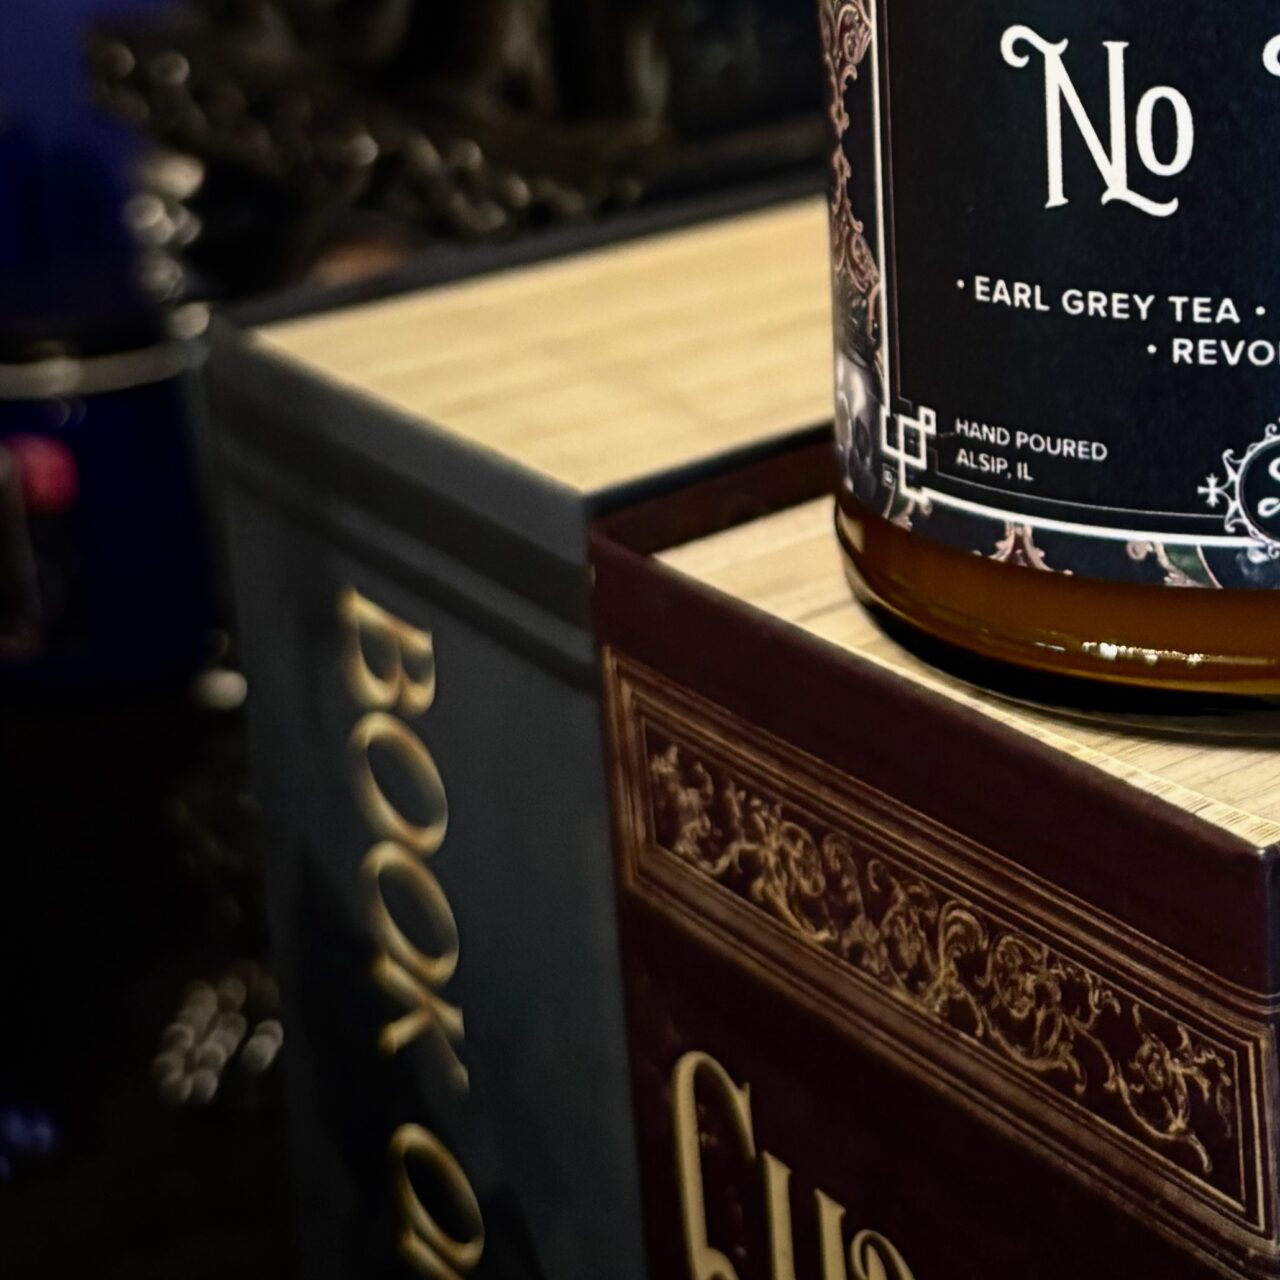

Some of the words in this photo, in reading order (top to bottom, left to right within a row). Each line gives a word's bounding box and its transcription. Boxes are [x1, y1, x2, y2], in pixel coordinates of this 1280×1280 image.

[974, 275, 1051, 312] EARL
[1061, 288, 1156, 321] GREY
[1167, 295, 1241, 324] TEA
[955, 417, 1011, 446] HAND
[1015, 430, 1109, 462] POURED
[956, 448, 1013, 480] ALSIP,
[1016, 462, 1035, 481] IL
[338, 584, 471, 1095] BOOK
[388, 1120, 486, 1280] O
